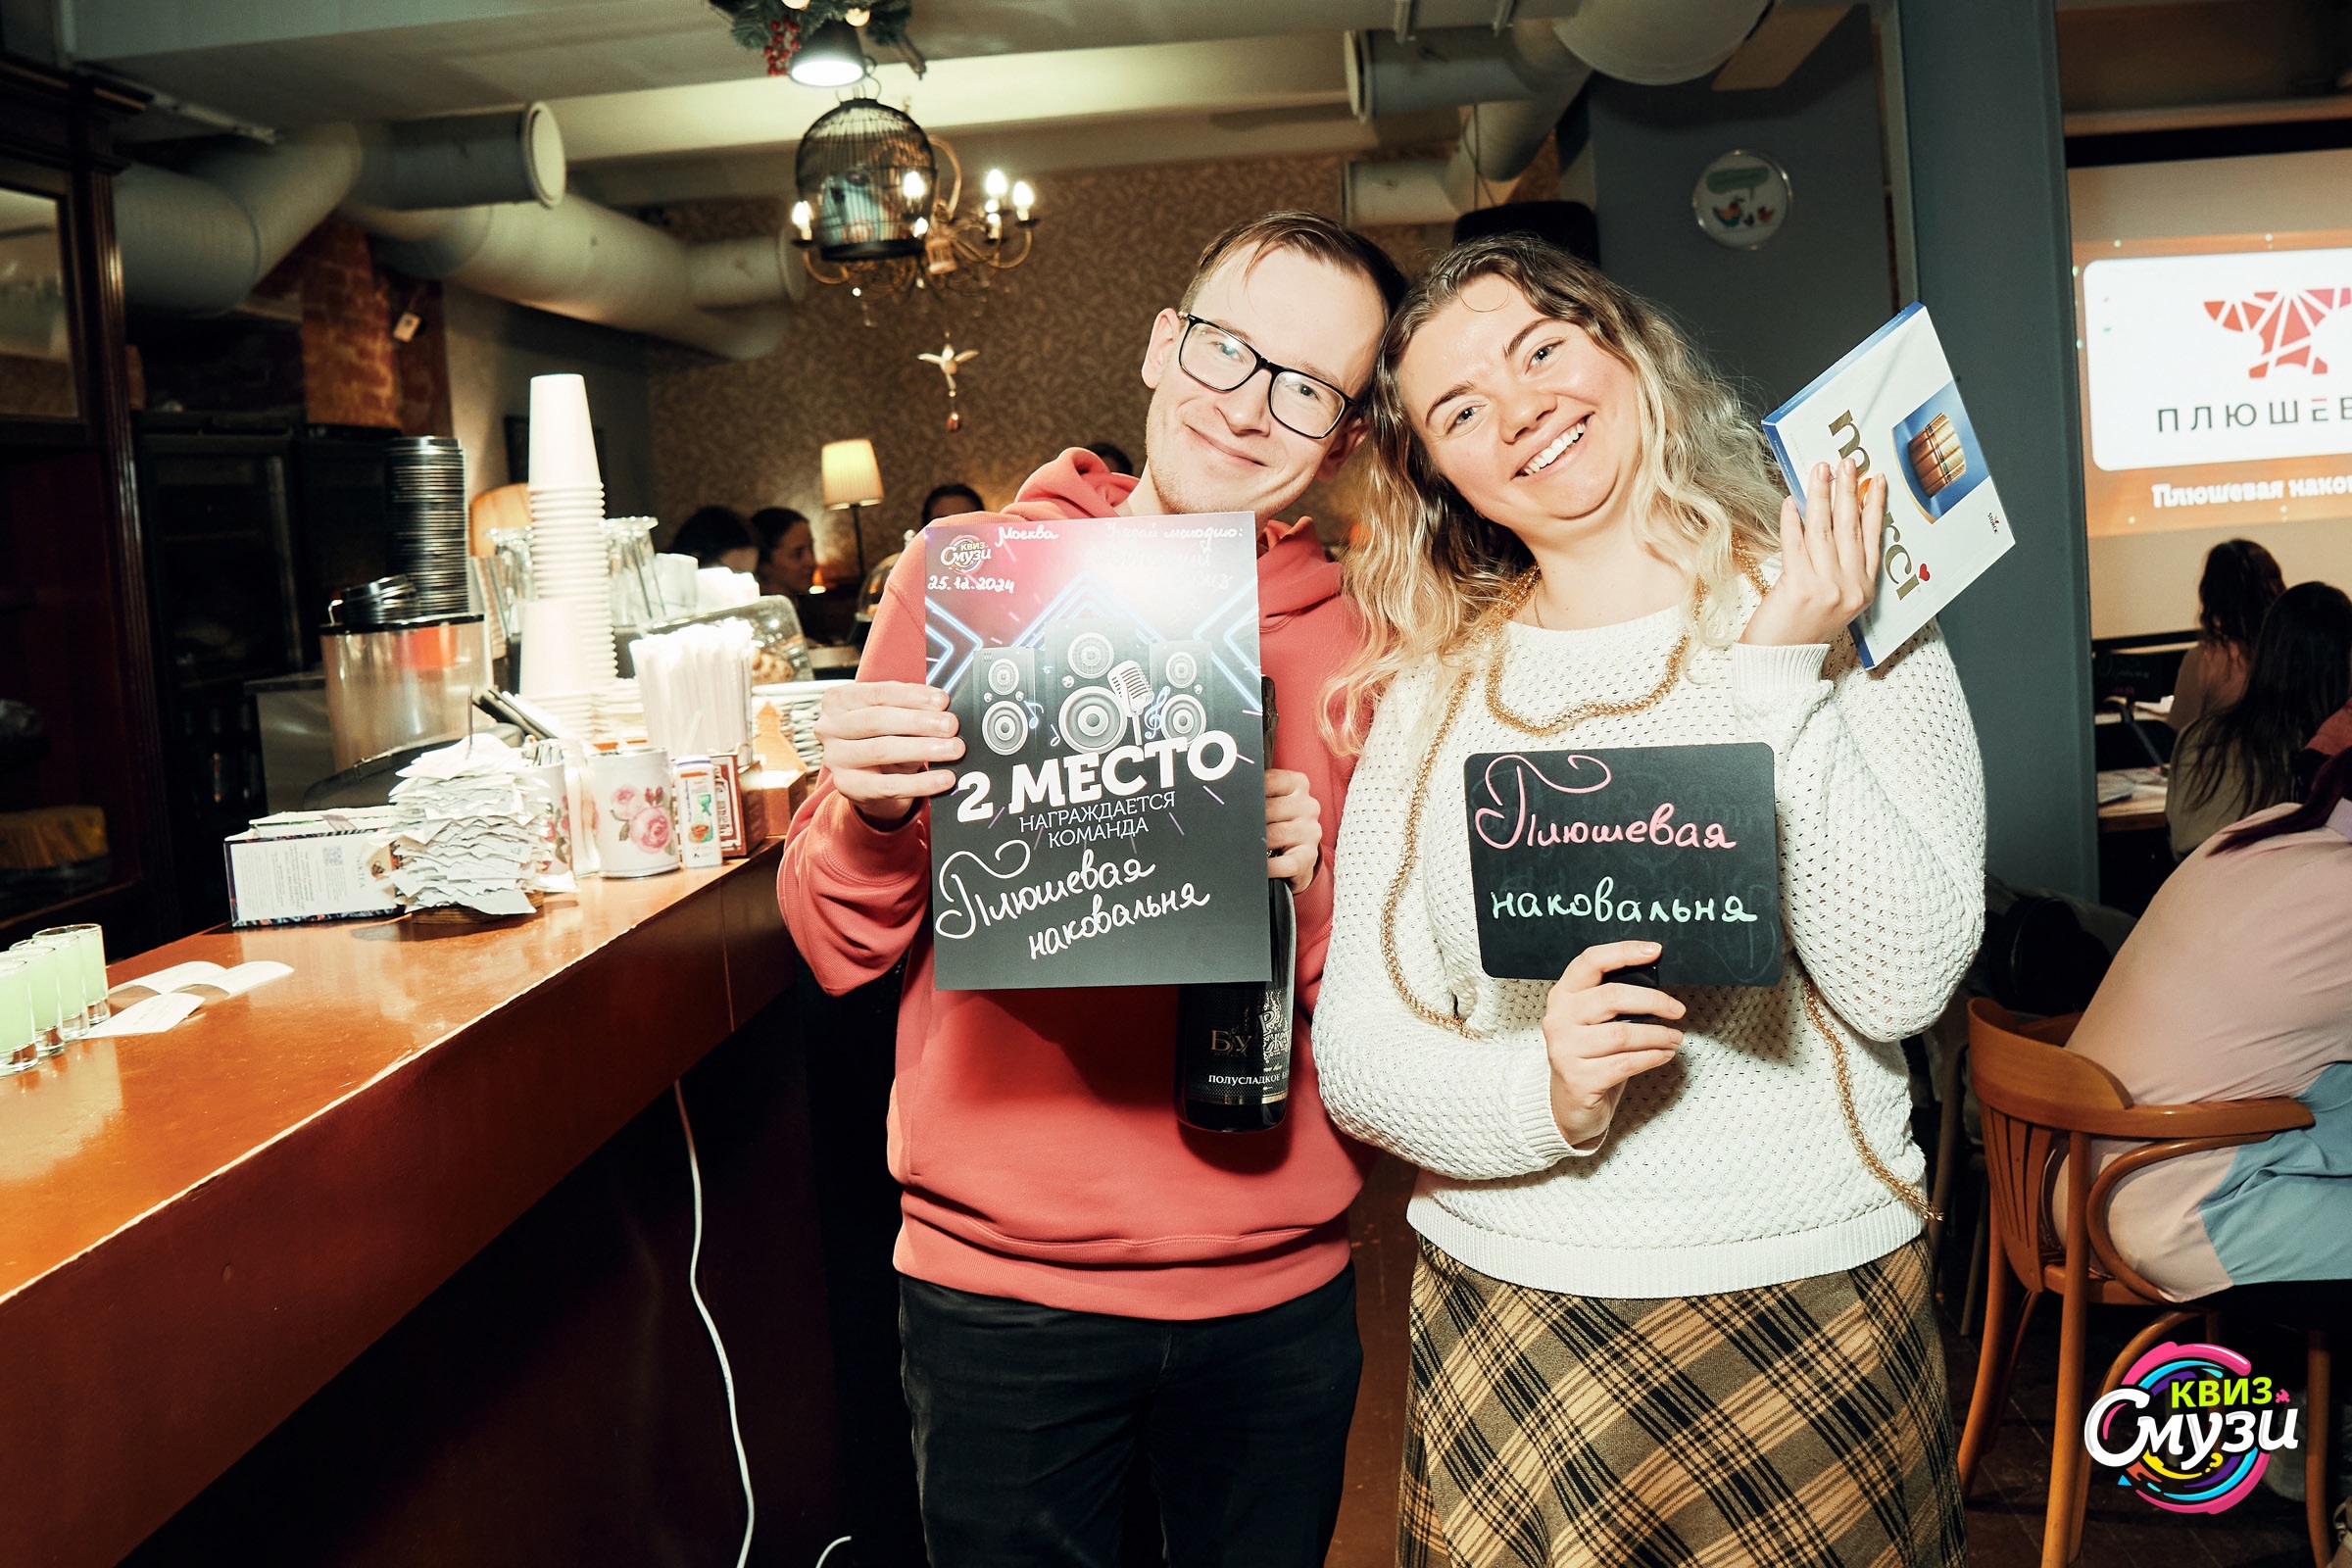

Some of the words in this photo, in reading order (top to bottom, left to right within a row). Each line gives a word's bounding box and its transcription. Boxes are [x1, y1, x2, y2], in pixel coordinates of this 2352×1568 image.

[1829, 409, 1929, 601] mrci
[2151, 480, 2284, 508] Плюшевая
[960, 541, 985, 551] КВИЗ
[995, 524, 1058, 547] Москва
[927, 575, 1014, 594] 25.12.2024
[957, 771, 994, 822] 2
[1008, 730, 1238, 815] МЕСТО
[1019, 791, 1175, 832] НАГРАЖДАЕТСЯ
[1475, 755, 1737, 850] Плюшевая
[1048, 817, 1149, 849] КОМАНДА
[936, 840, 1155, 939] Плюшевая
[1491, 876, 1757, 922] наковальня
[1029, 882, 1210, 959] наковальня
[1208, 1073, 1280, 1086] ПОЛУСЛАДКОЕ
